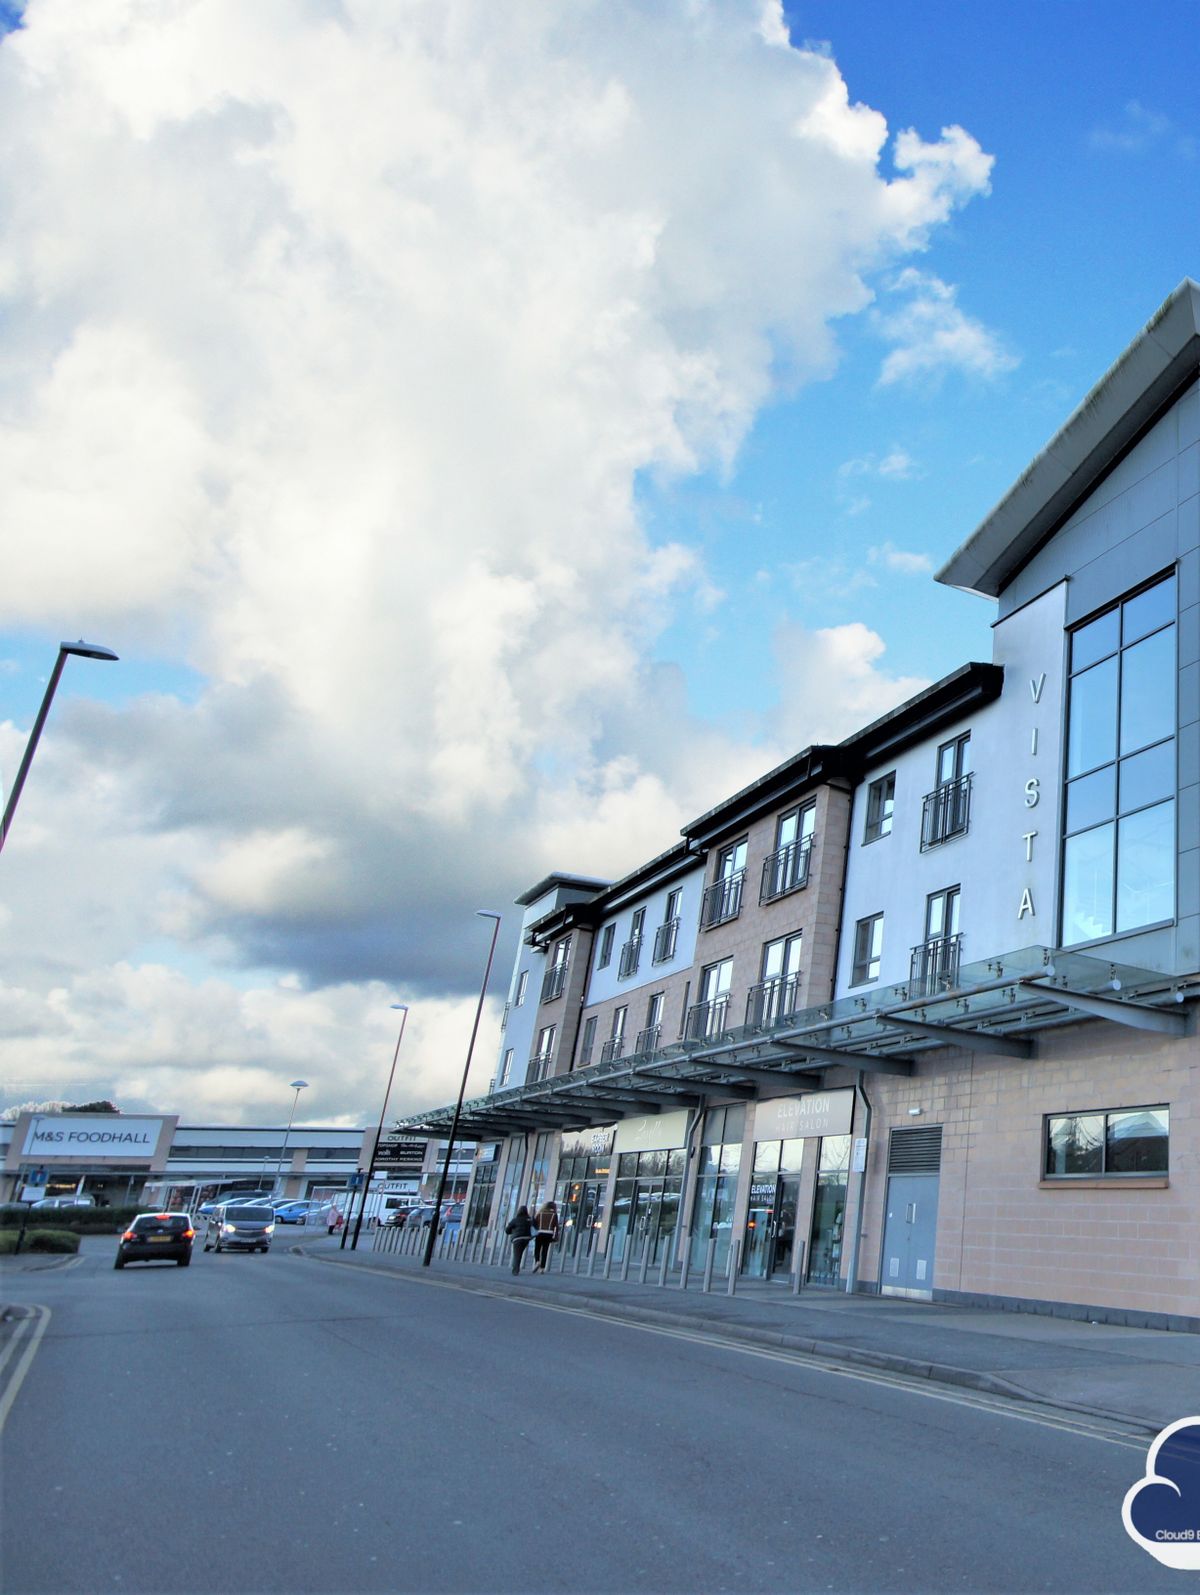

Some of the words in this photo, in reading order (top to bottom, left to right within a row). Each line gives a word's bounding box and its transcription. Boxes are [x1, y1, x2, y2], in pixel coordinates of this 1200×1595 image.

[1018, 672, 1046, 920] VISTA
[777, 1096, 831, 1118] ELEVATION
[799, 1118, 830, 1131] SALON
[34, 1131, 64, 1143] M&S
[68, 1131, 150, 1144] FOODHALL
[378, 1182, 408, 1190] OUTFIT
[751, 1184, 776, 1194] ELEVATION
